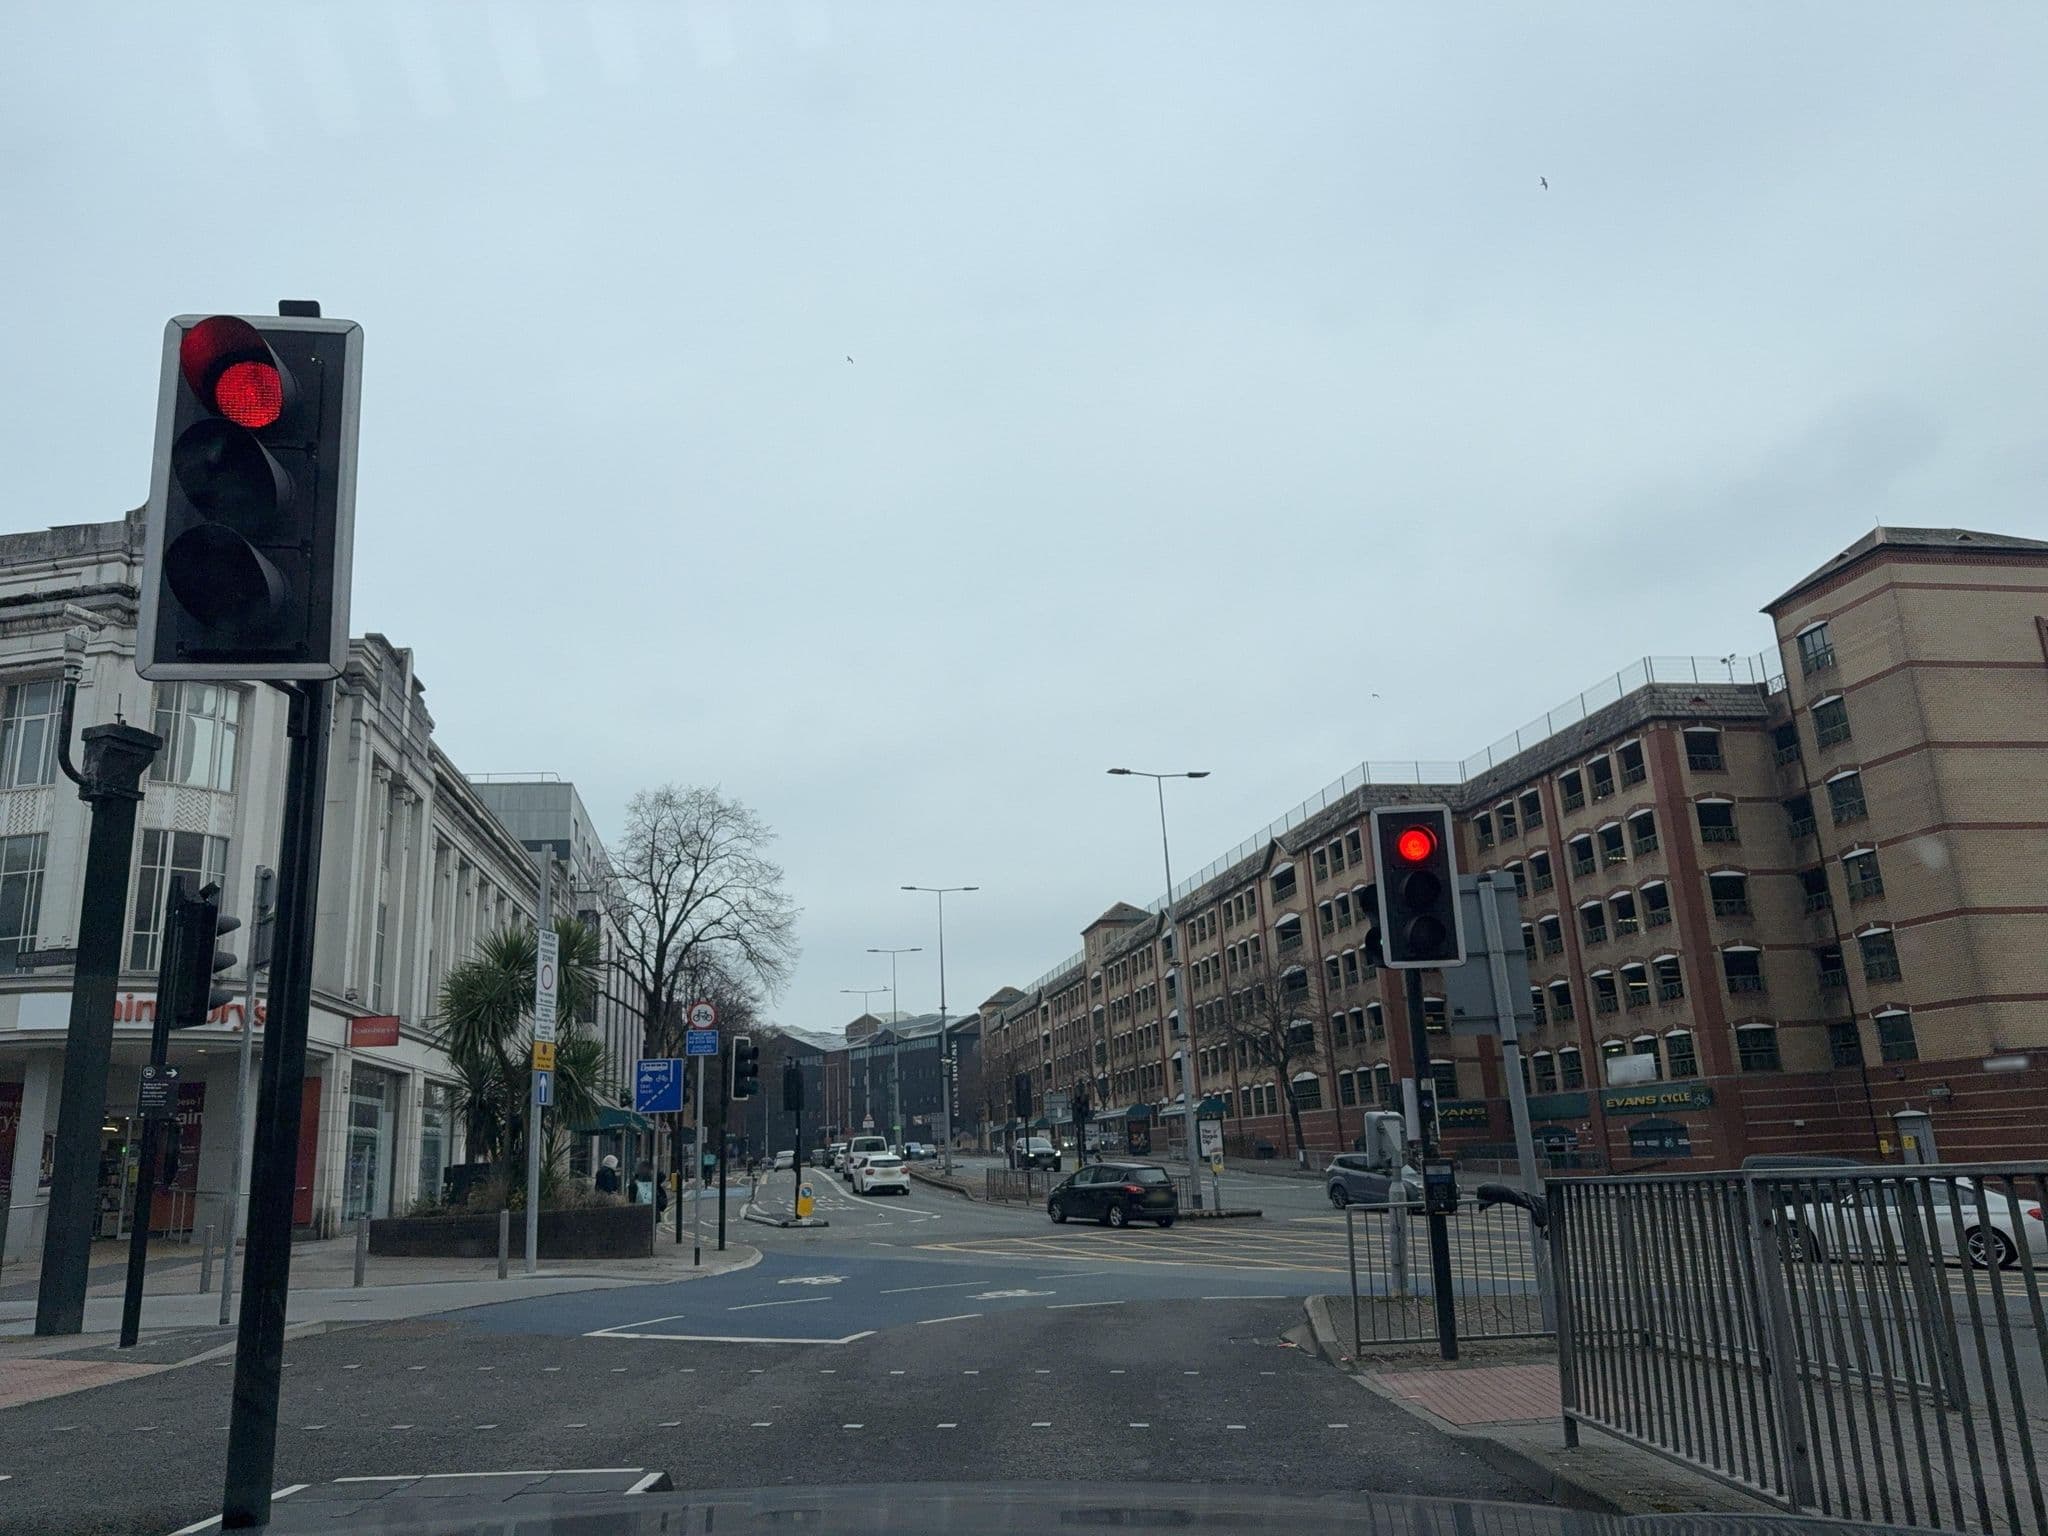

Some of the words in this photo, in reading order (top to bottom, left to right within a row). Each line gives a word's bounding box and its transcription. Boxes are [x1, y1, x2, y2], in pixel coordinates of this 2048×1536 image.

[1606, 1095, 1657, 1109] EVANS
[1661, 1092, 1691, 1104] CYCLE
[1437, 1108, 1486, 1117] VANS
